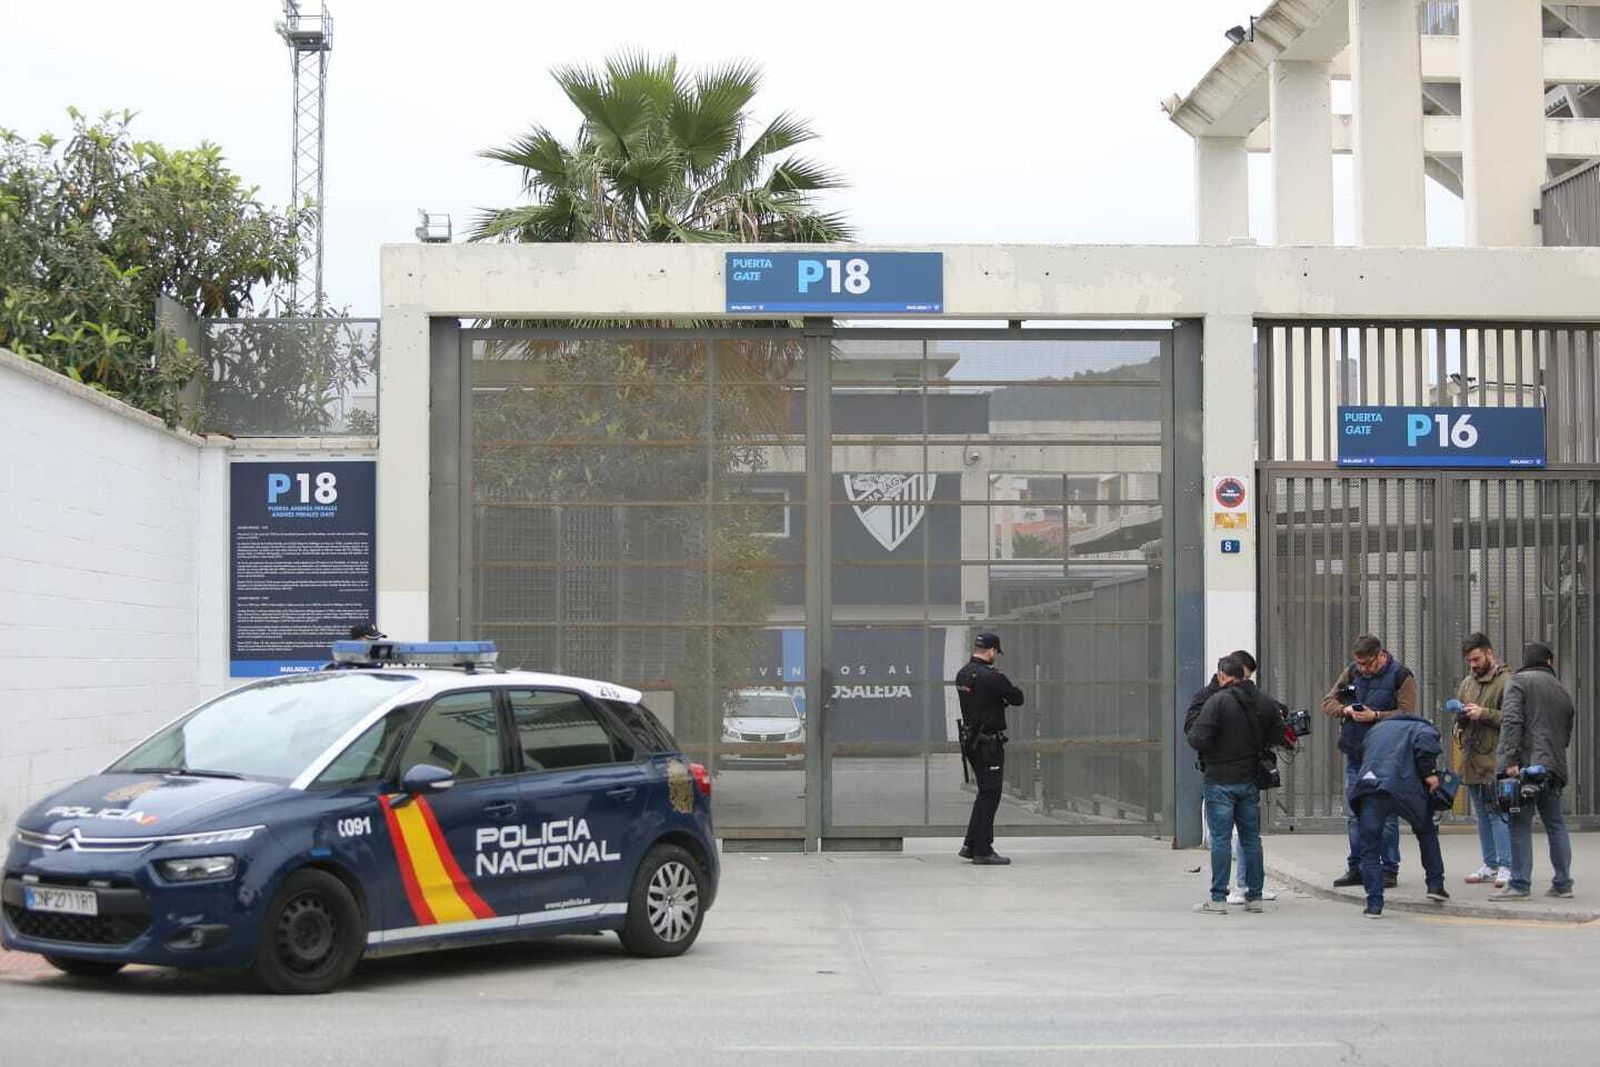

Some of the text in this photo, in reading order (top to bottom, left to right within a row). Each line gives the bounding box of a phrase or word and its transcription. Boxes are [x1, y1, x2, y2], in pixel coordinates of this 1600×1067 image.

[733, 258, 773, 269] PUERTA
[733, 271, 762, 281] GATE
[798, 258, 871, 295] P18
[1344, 412, 1383, 422] PUERTA
[1345, 425, 1372, 435] GATE
[1407, 413, 1478, 449] P16
[267, 472, 338, 504] P18
[344, 816, 372, 837] 091
[476, 839, 621, 877] NACIONAL
